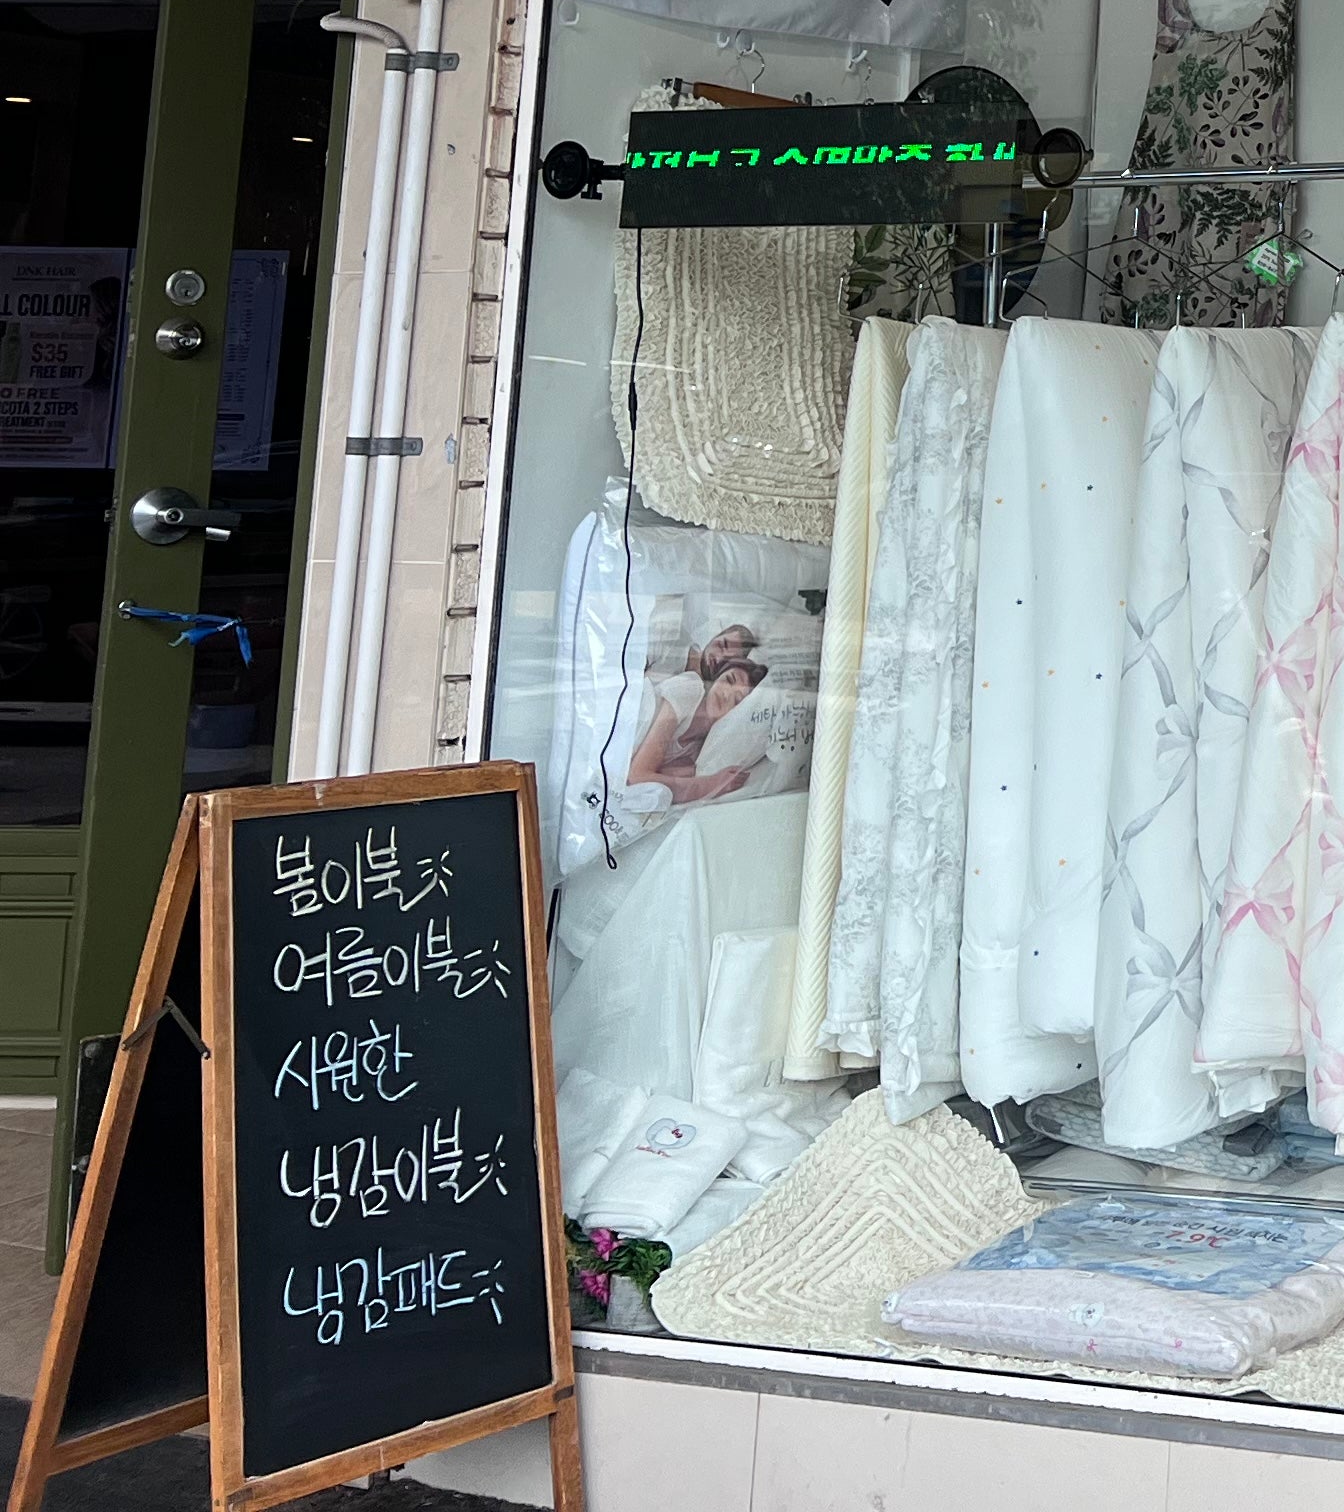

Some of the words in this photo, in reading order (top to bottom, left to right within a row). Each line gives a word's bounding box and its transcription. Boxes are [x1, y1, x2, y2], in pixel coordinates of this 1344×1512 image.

[17, 293, 91, 317] COLOUR
[31, 342, 69, 363] $35
[30, 365, 57, 379] FREE
[60, 365, 84, 379] GIFT
[17, 387, 60, 399] FREE
[33, 401, 41, 416] 2
[44, 401, 79, 416] STEPS
[274, 1019, 419, 1110] 시원한
[283, 1246, 476, 1346] 냉감패드
